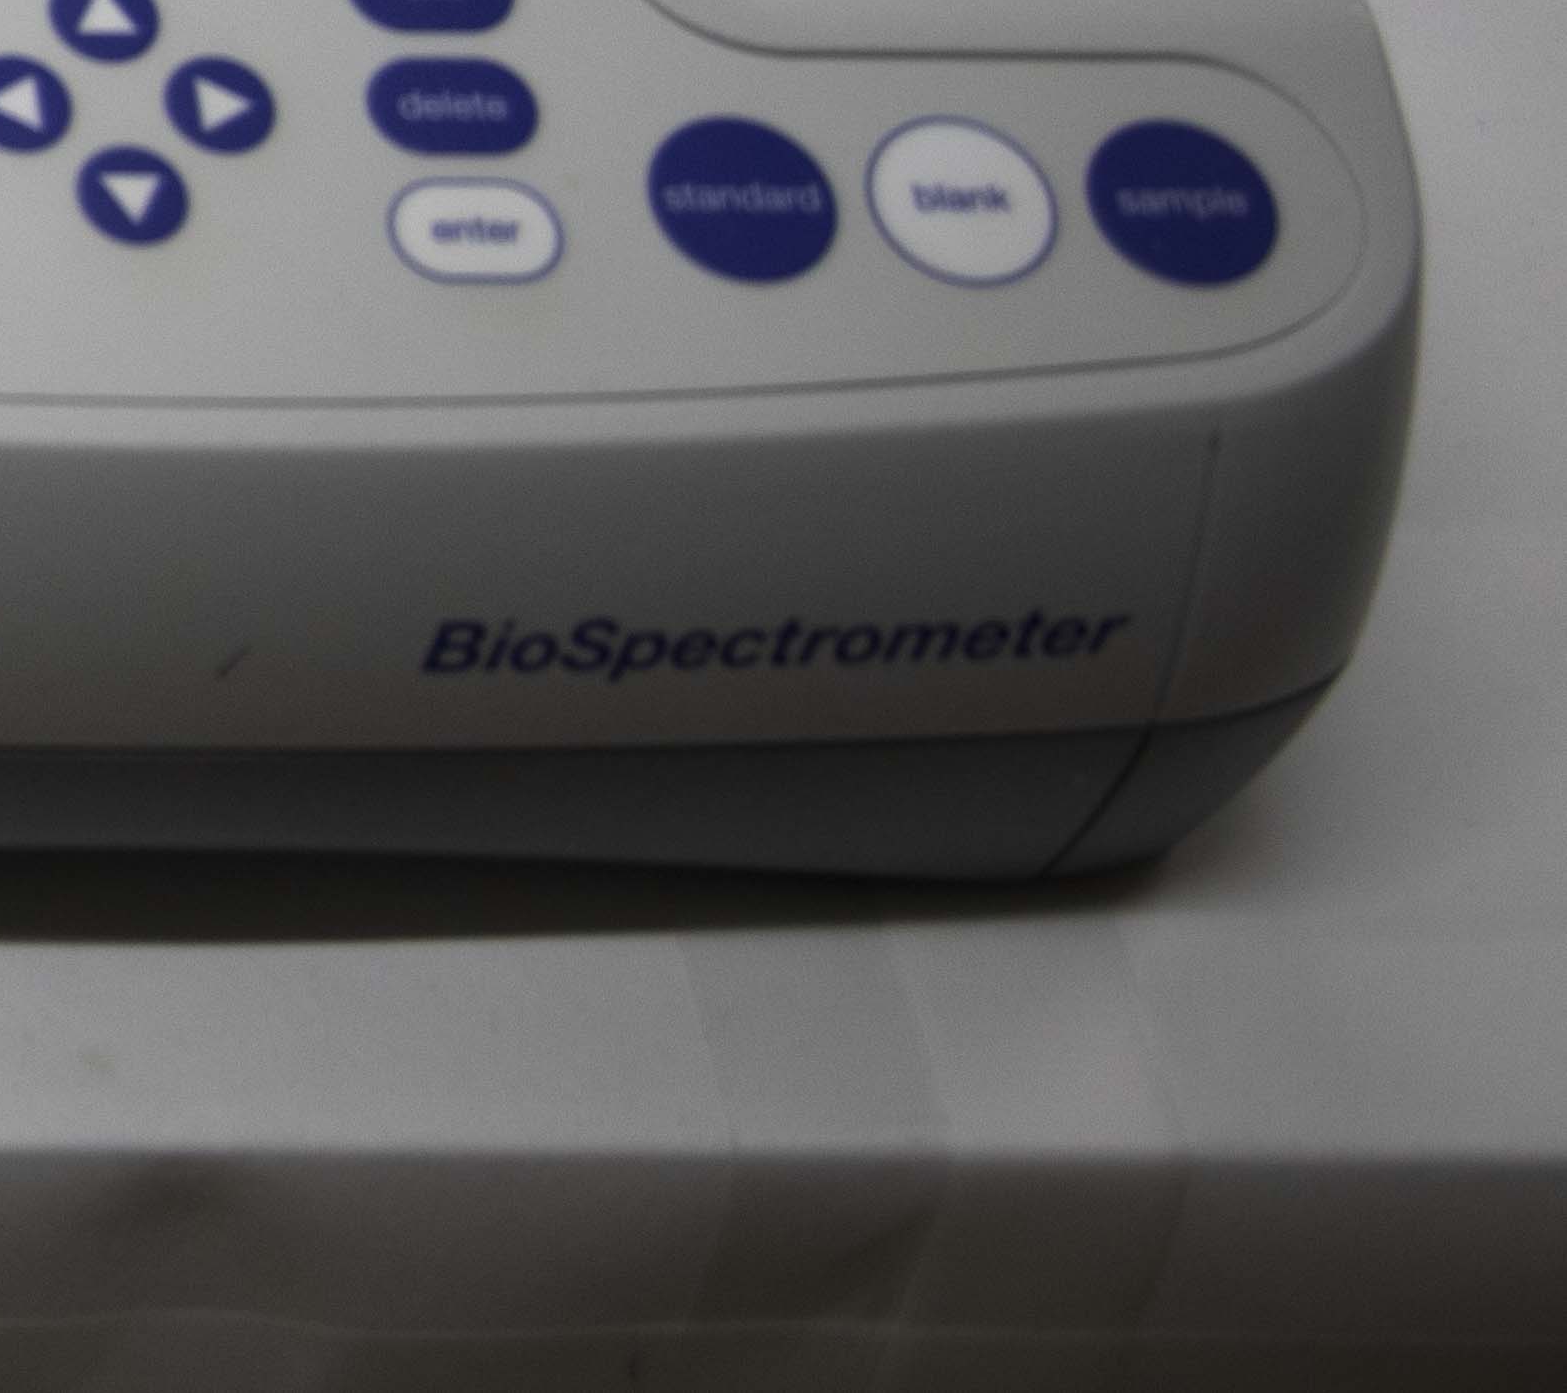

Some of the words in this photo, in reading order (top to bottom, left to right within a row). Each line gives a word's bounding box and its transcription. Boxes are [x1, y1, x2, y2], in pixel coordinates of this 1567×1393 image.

[398, 90, 507, 122] delete
[662, 180, 822, 216] standard
[914, 180, 1012, 216] blank
[1117, 186, 1250, 224] sample
[431, 215, 520, 244] enter
[421, 610, 1130, 684] BioSpectrometer
